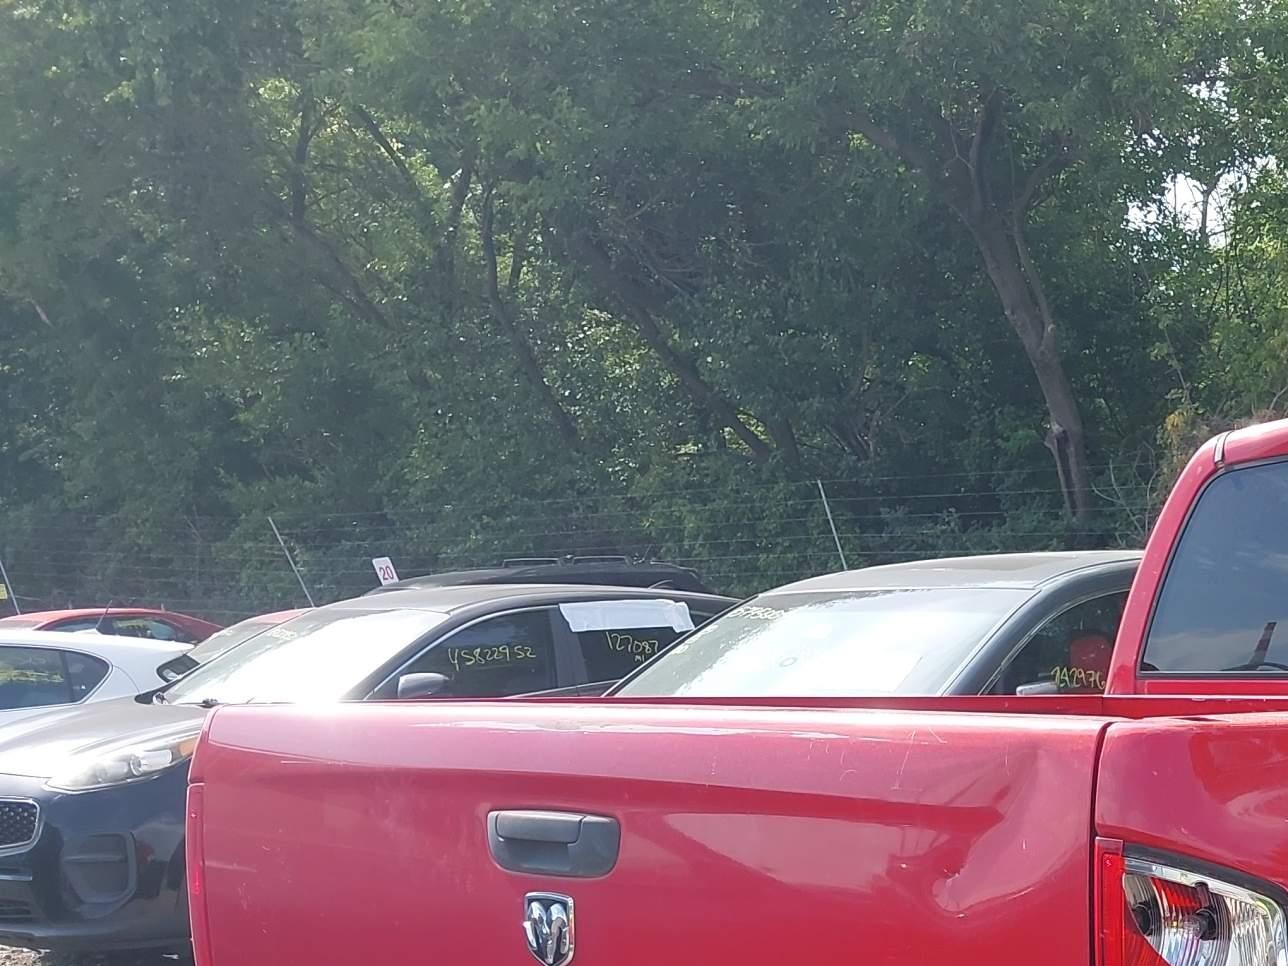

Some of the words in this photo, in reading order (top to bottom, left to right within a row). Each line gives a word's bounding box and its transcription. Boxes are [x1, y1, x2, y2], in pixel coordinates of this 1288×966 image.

[379, 565, 395, 580] 20
[605, 631, 659, 654] 127087
[447, 645, 537, 672] 45822952
